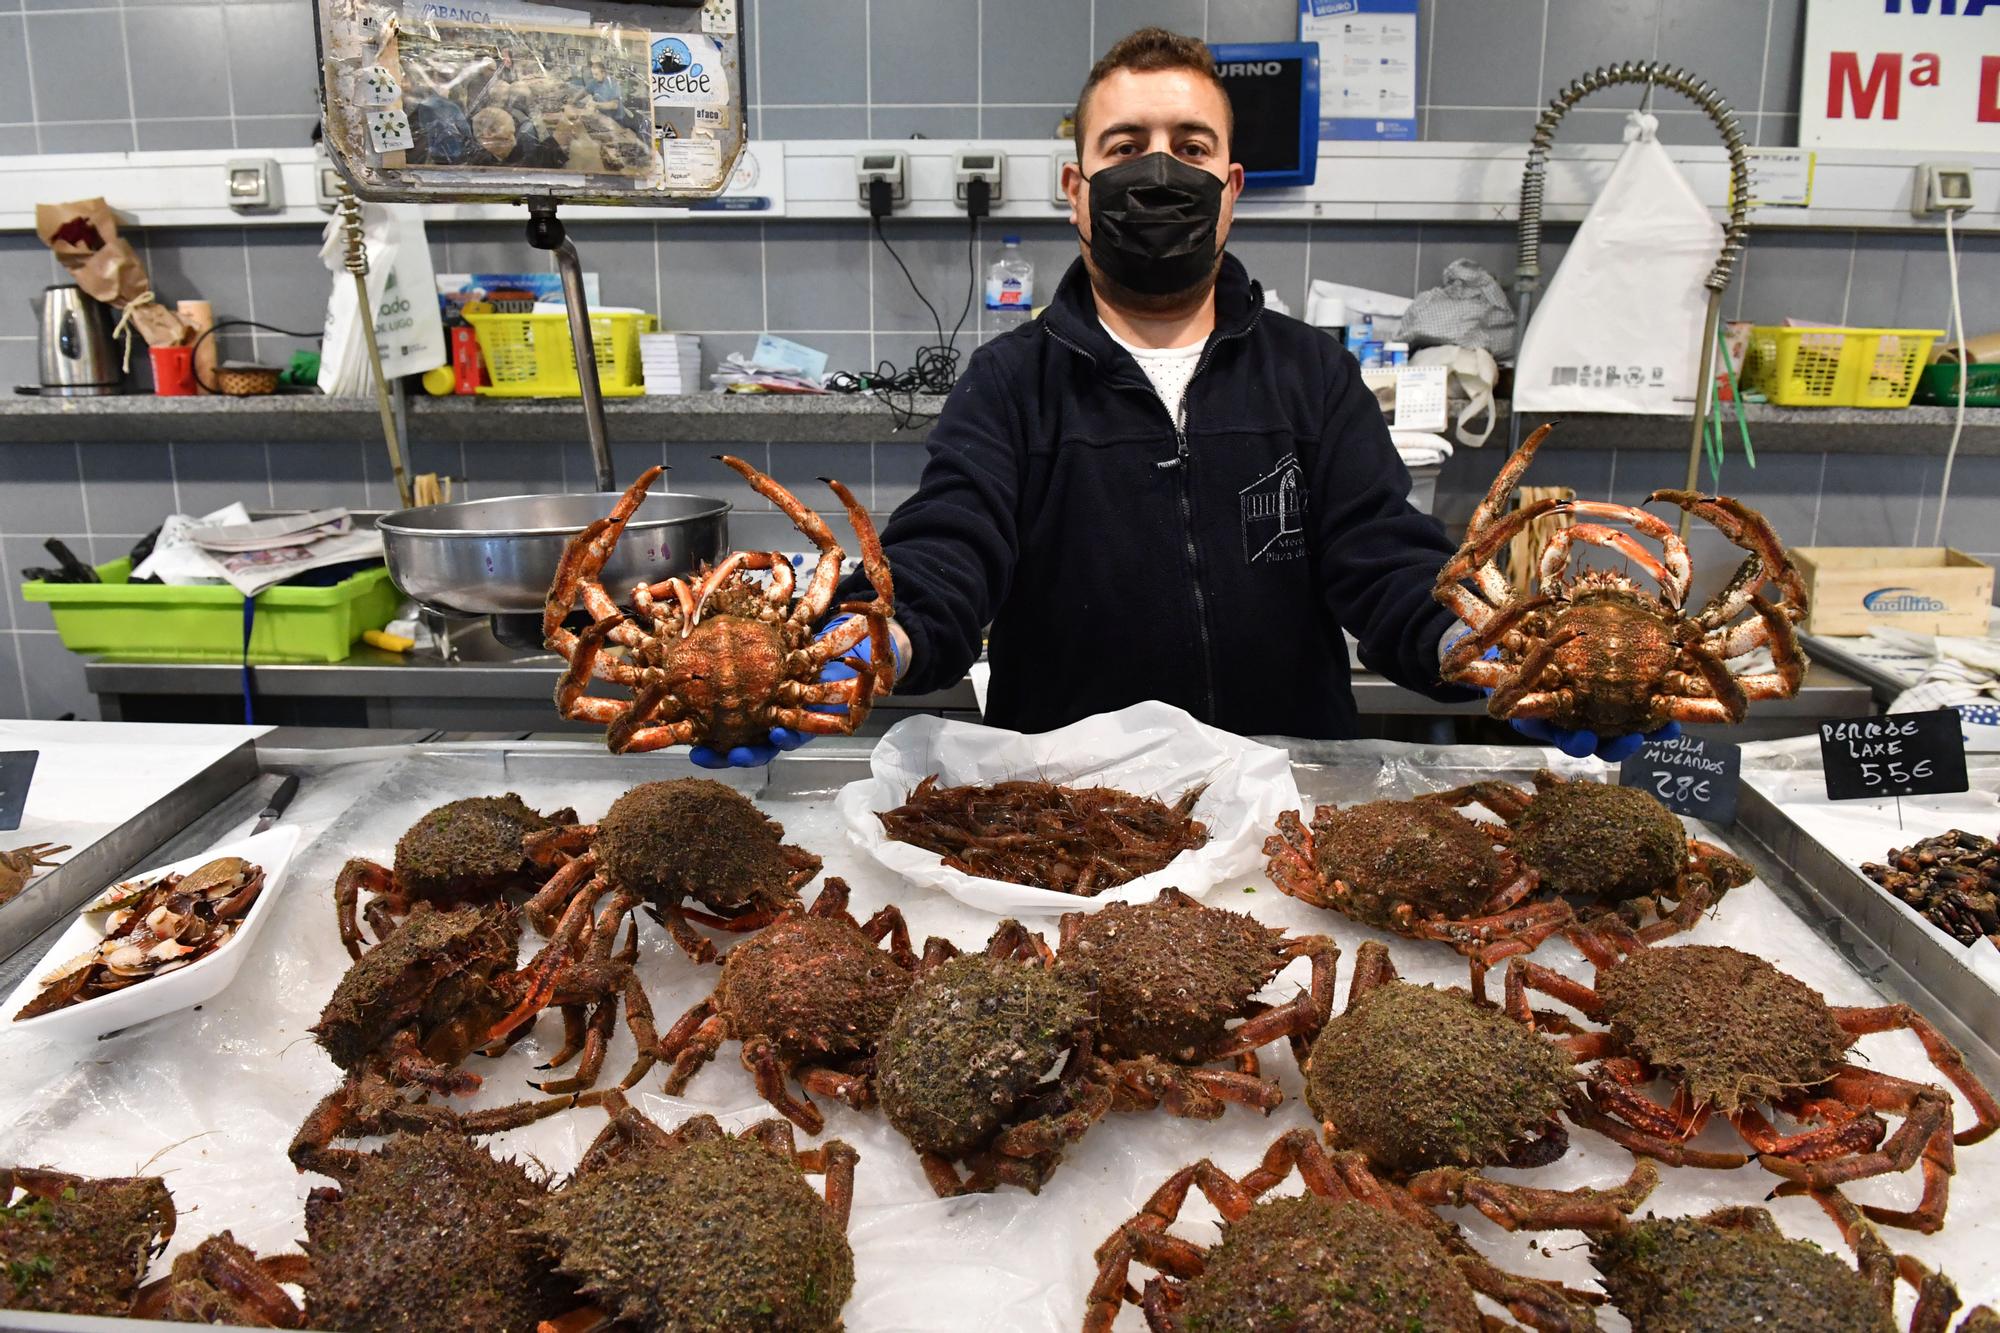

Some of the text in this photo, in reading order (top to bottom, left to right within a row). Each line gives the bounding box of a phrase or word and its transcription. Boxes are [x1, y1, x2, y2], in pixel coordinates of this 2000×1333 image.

[429, 4, 491, 24] ABANCA
[1213, 61, 1282, 77] URNO
[696, 109, 719, 120] afaco
[379, 296, 411, 316] ado
[1849, 740, 1903, 758] LAXE
[1652, 770, 1711, 801] 28€
